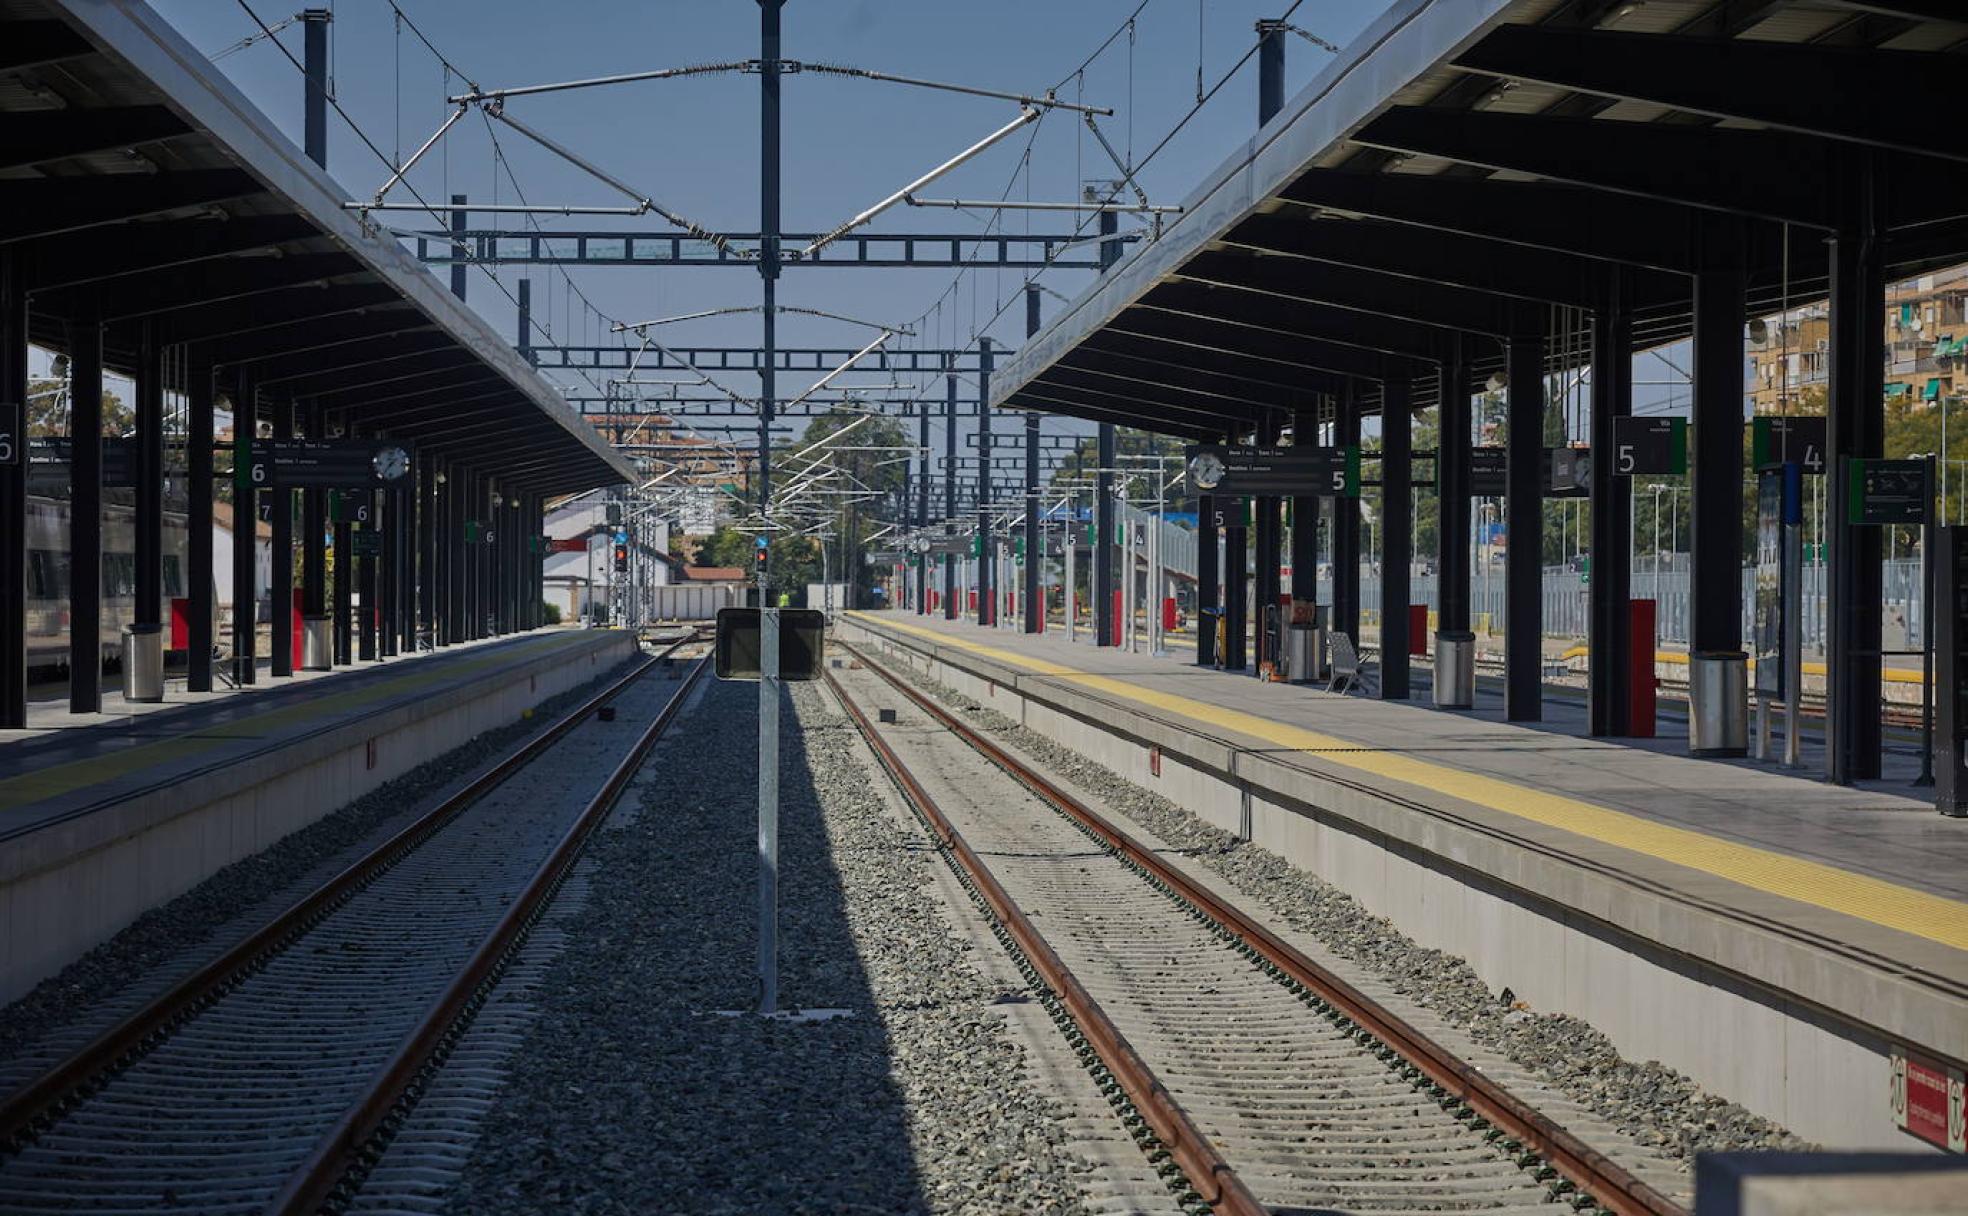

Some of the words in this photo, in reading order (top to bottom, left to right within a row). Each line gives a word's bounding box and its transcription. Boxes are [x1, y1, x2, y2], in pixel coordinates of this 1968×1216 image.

[1620, 444, 1635, 472] 5
[1804, 444, 1823, 471] 4
[251, 463, 266, 482] 6
[1332, 471, 1346, 491] 5
[261, 505, 271, 520] 7
[357, 505, 368, 521] 6
[1215, 510, 1224, 526] 5
[486, 531, 495, 543] 6
